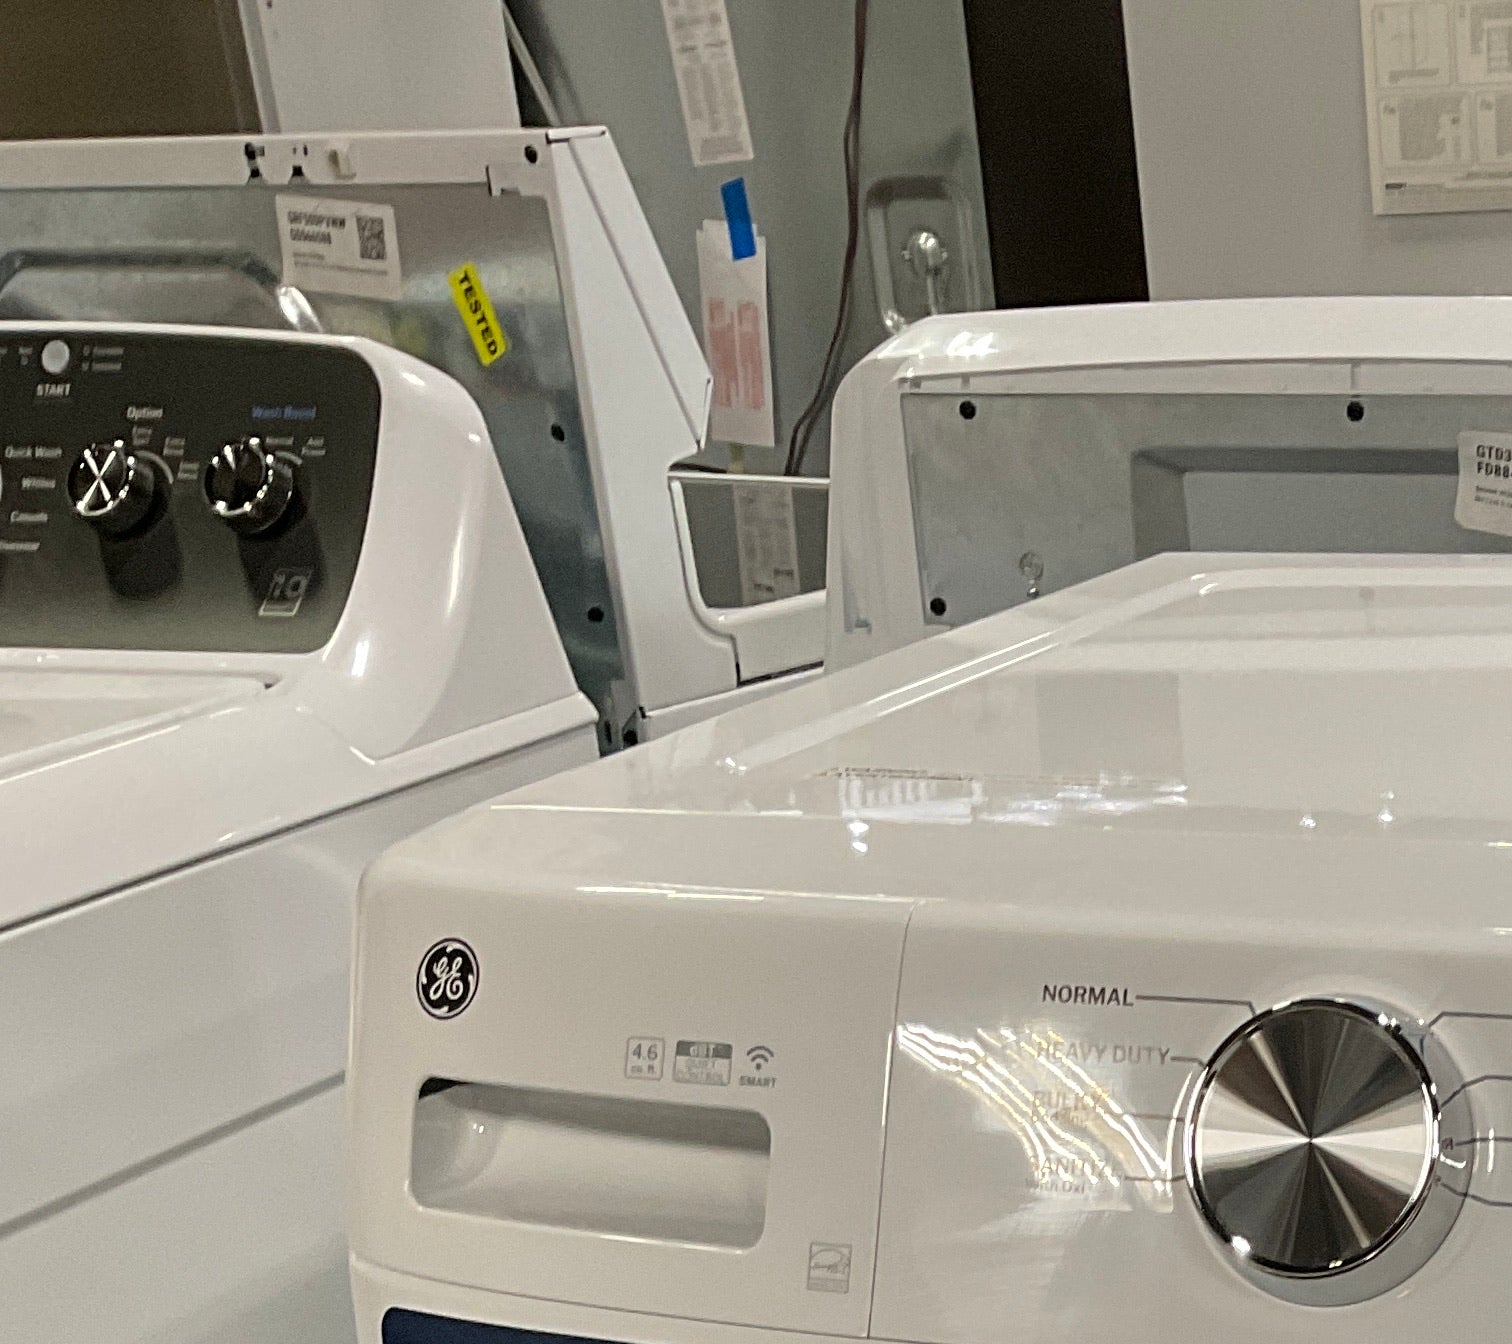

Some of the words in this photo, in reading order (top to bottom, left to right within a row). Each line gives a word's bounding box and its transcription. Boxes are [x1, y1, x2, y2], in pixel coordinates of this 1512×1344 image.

[459, 271, 498, 356] TESTED
[1042, 984, 1134, 1007] NORMAL
[632, 1042, 658, 1061] 4.6
[1036, 1041, 1108, 1062] HEAVY
[1113, 1045, 1169, 1064] DUTY
[739, 1075, 777, 1088] SMART
